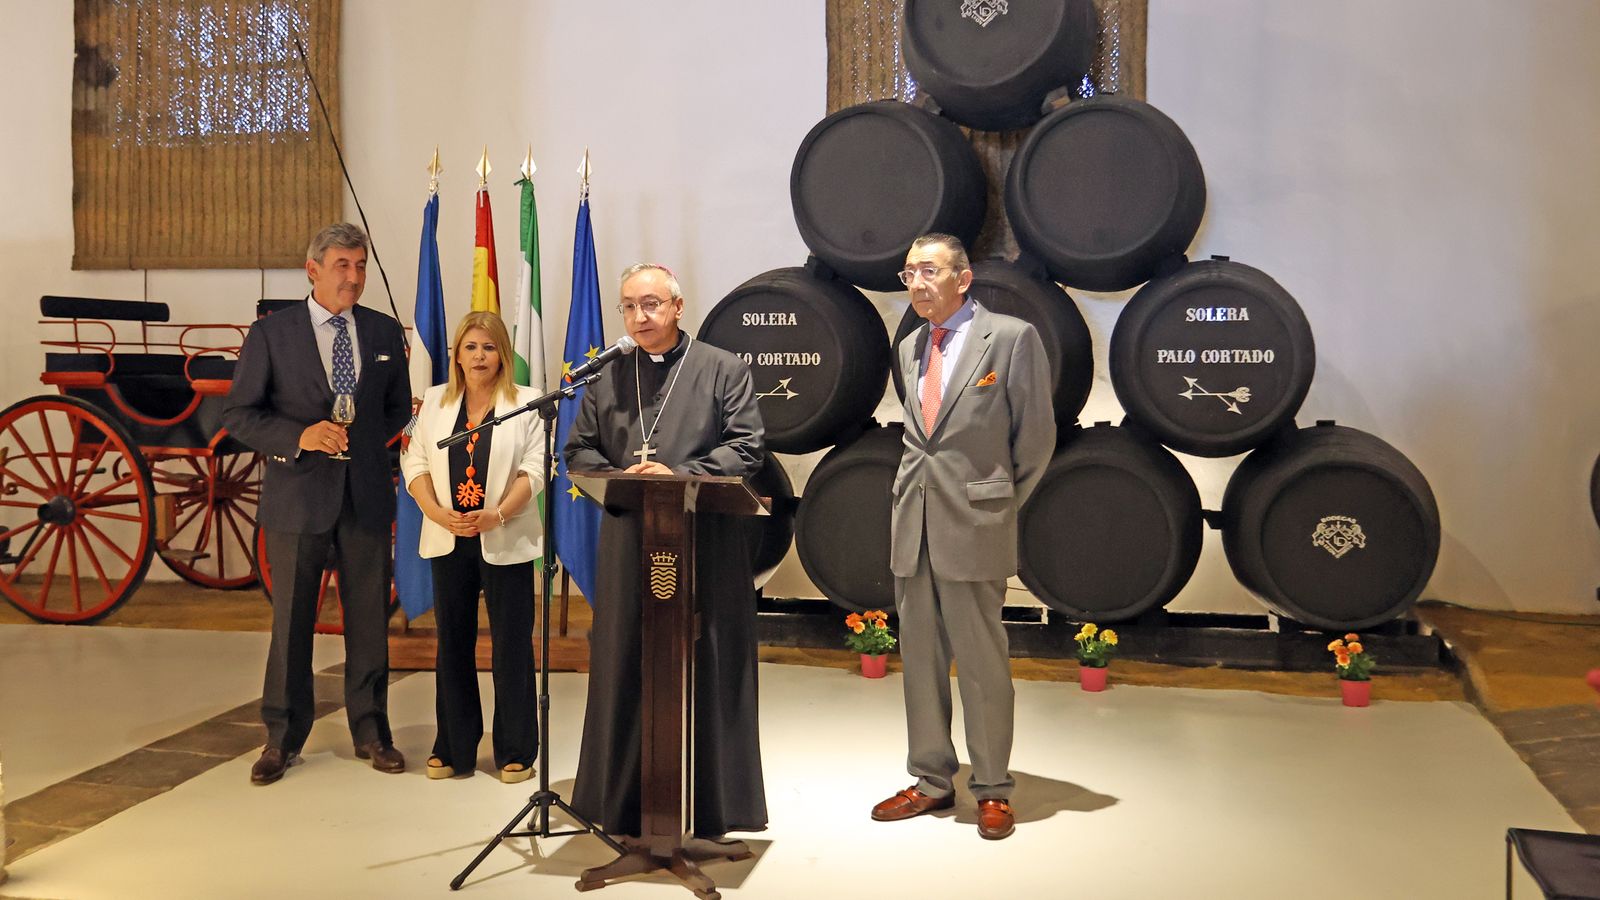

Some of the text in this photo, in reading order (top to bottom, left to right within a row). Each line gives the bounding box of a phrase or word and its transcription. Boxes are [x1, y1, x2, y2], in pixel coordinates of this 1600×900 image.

[742, 312, 798, 327] SOLERA
[1185, 306, 1250, 322] SOLERA
[756, 352, 821, 366] CORTADO
[1157, 349, 1275, 364] PALO CORTADO
